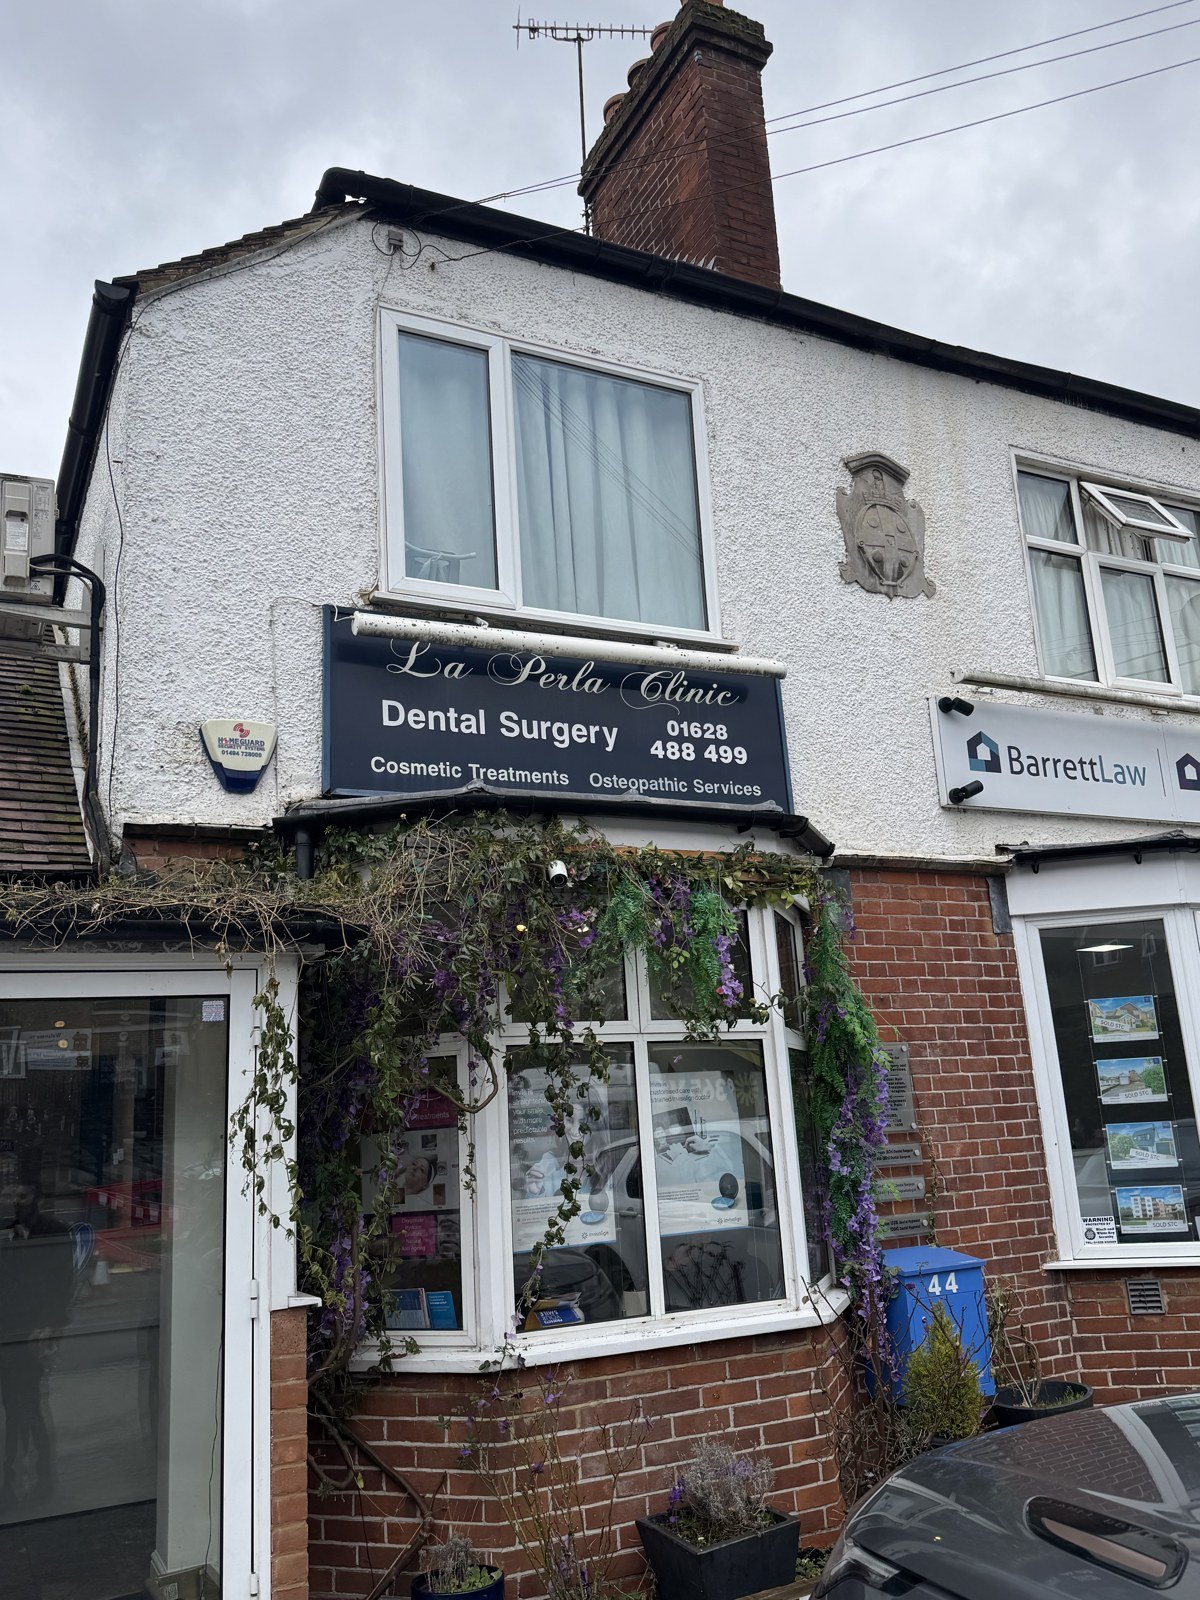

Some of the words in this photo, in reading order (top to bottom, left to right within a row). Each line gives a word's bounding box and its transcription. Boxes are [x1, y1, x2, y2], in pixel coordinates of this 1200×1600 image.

[385, 638, 474, 680] La
[486, 651, 611, 694] Perla
[619, 670, 740, 716] Clinic
[381, 699, 486, 735] Dental
[499, 710, 619, 752] Surgery
[666, 719, 728, 740] 01628
[649, 740, 696, 761] 488
[703, 744, 748, 765] 499
[370, 755, 463, 778] Cosmetic
[467, 763, 570, 785] Treatments
[1006, 745, 1147, 787] BarrettLaw
[588, 772, 689, 793] Osteopathic
[693, 778, 762, 797] Services
[1100, 1019, 1115, 1028] SOLD
[1124, 1091, 1139, 1099] SOLD
[513, 1125, 548, 1136] predictable
[1135, 1150, 1150, 1158] SOLD
[1150, 1153, 1160, 1161] STC
[928, 1271, 959, 1296] 44
